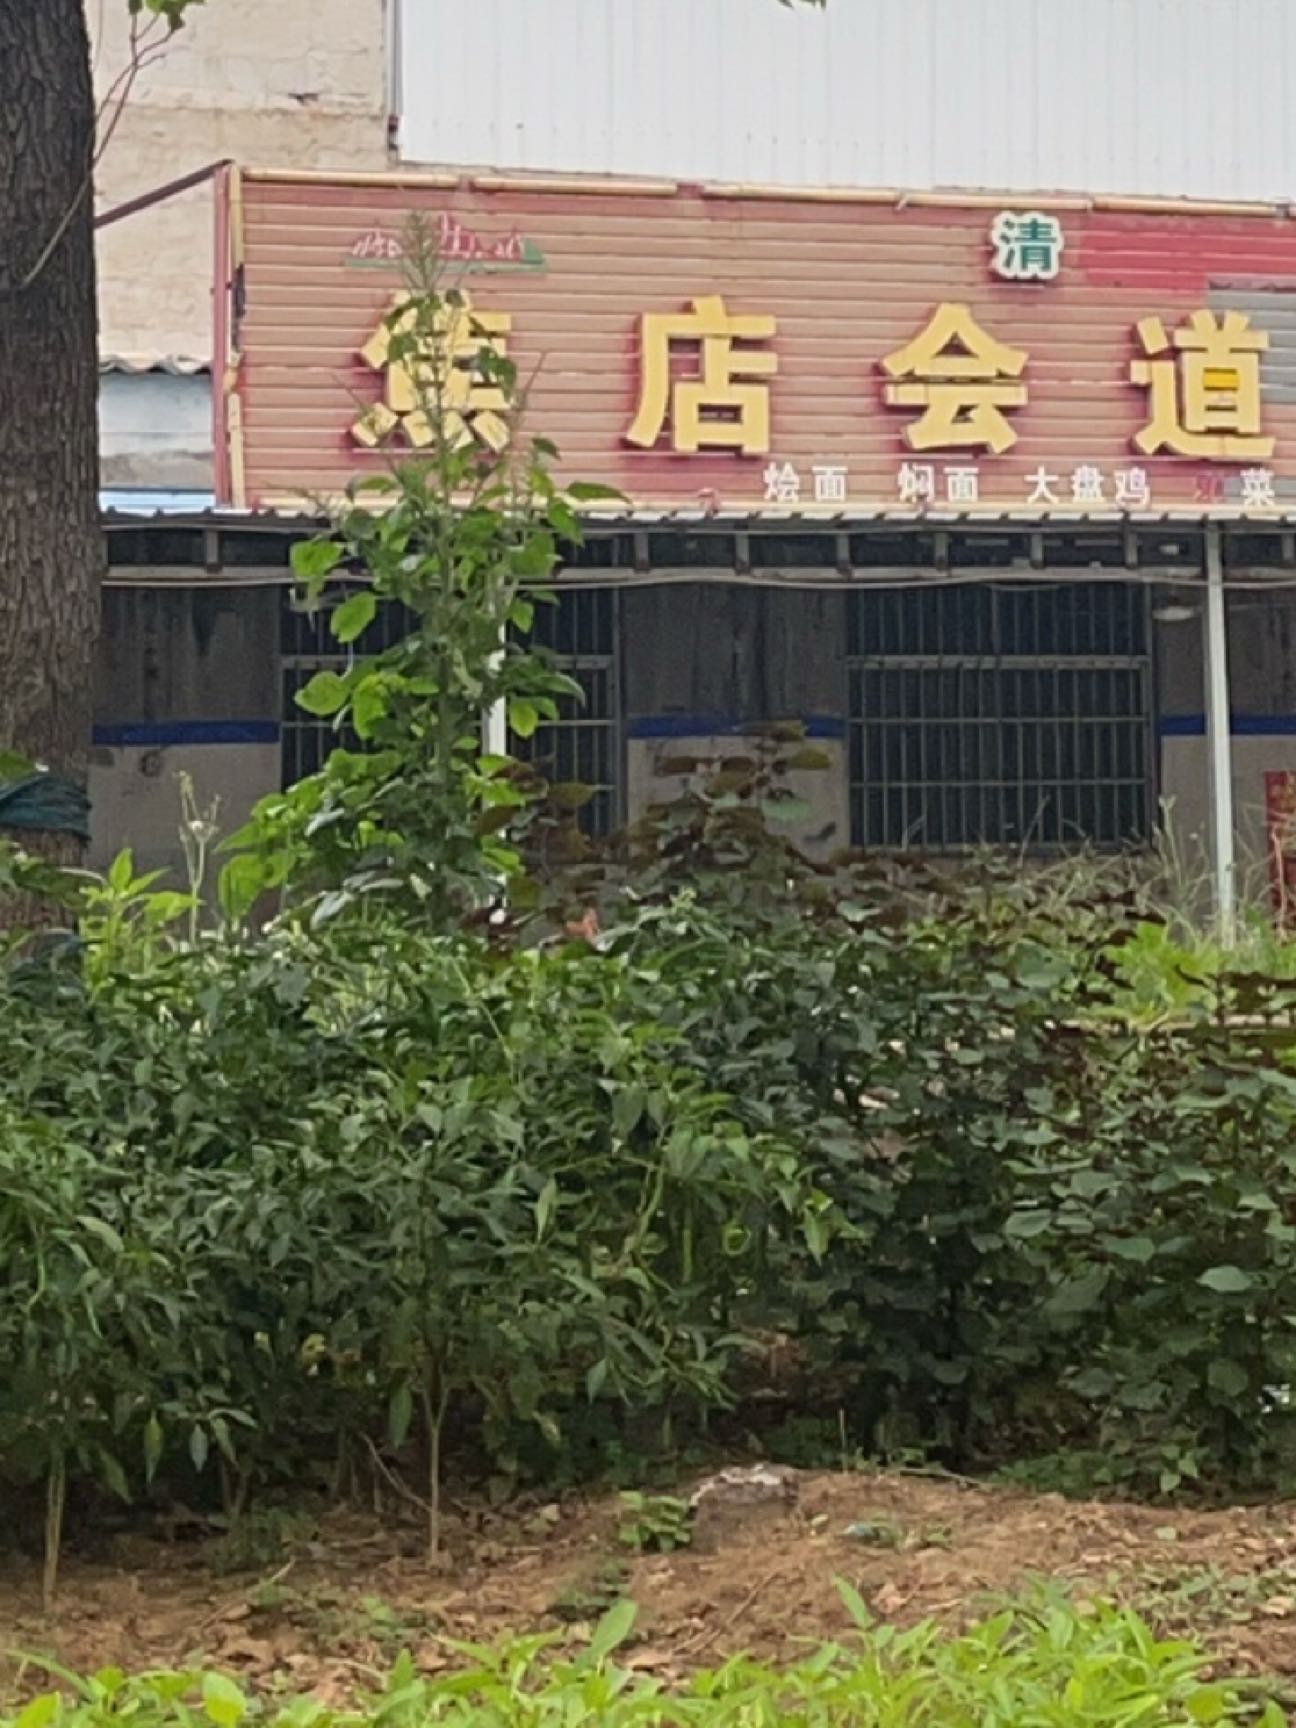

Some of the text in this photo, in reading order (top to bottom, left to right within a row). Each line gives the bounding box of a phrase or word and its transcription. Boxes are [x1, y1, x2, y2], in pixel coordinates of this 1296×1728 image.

[763, 461, 848, 503] 烩面
[1024, 465, 1151, 505] 大盘鸡
